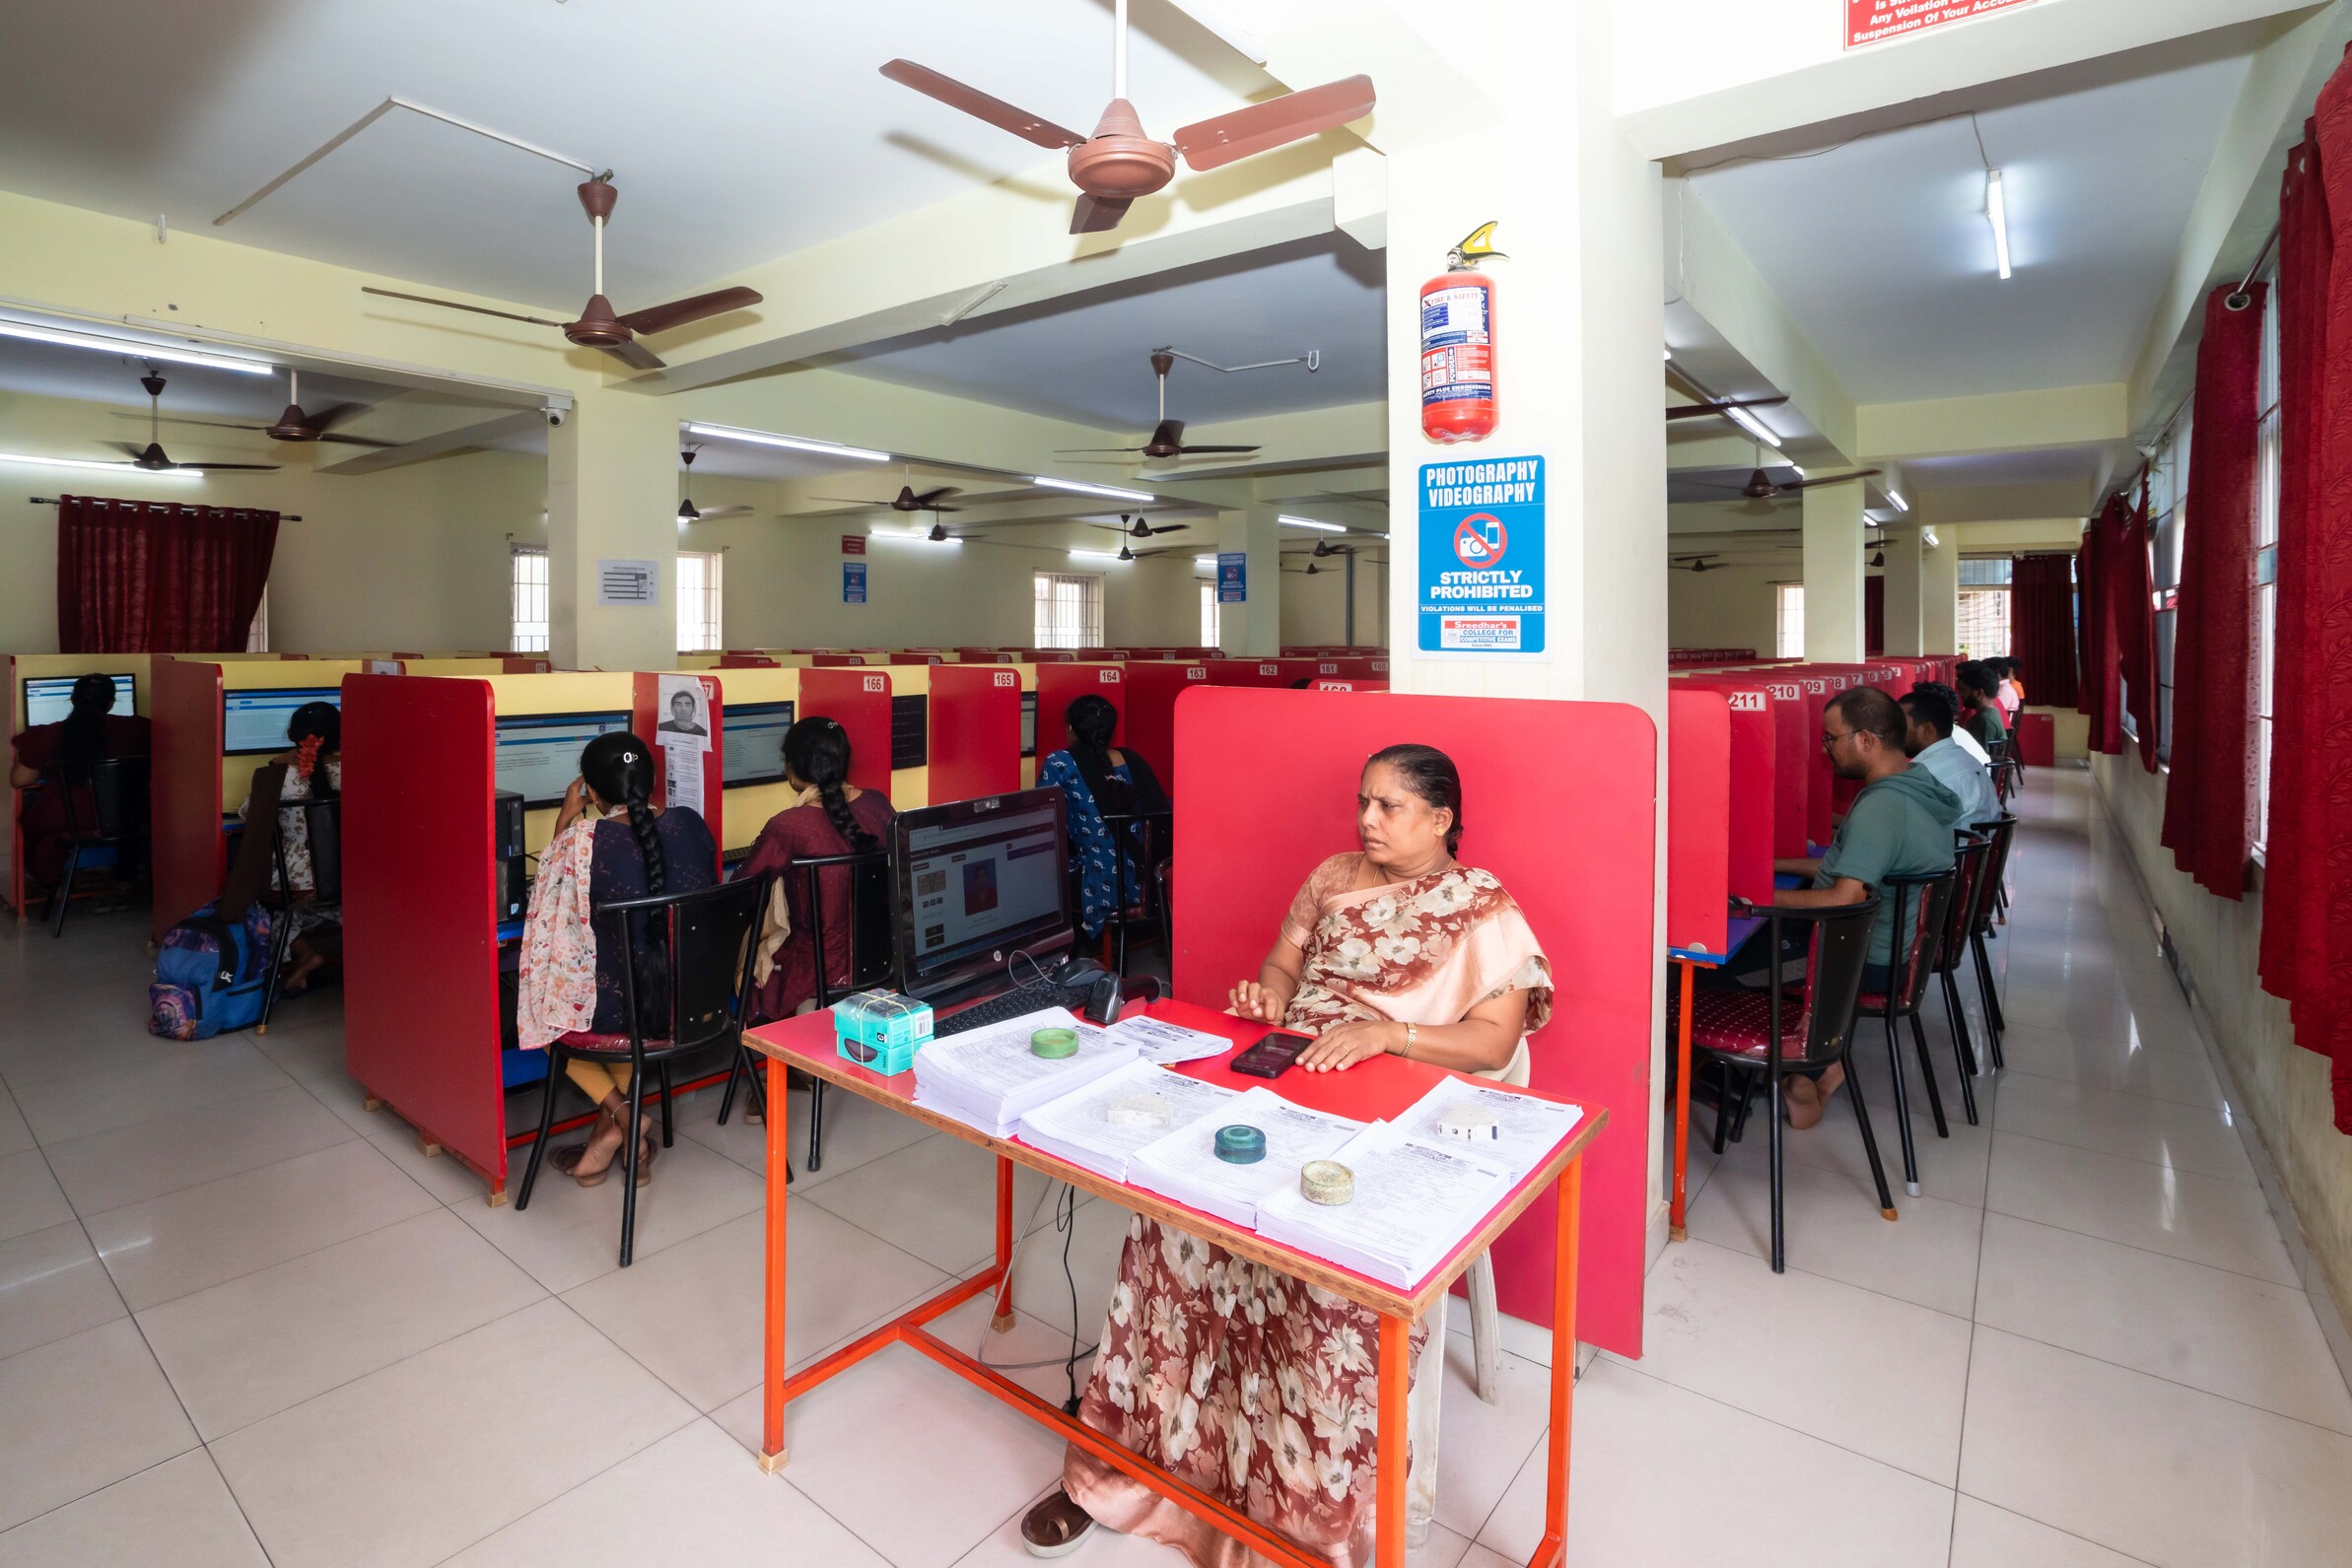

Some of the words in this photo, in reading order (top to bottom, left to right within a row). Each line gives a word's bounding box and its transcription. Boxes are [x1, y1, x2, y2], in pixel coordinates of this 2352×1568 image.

[1869, 13, 1893, 26] Any
[1896, 0, 1950, 19] Voilation
[1853, 19, 1922, 42] Suspension
[1924, 12, 1940, 25] Of
[1941, 6, 1971, 20] Your
[1431, 297, 1445, 306] FIRE
[1426, 460, 1538, 487] PHOTOGRAPHY
[1428, 482, 1535, 508] VIDEOGRAPHY
[1440, 571, 1523, 584] STRICTLY
[1430, 584, 1533, 599] PROHIBITED
[1189, 669, 1204, 678] 163
[1262, 665, 1276, 674] 162
[1321, 664, 1335, 673] 161
[996, 675, 1011, 685] 165
[1102, 671, 1117, 681] 164
[866, 678, 881, 690] 166
[1768, 685, 1795, 698] 210
[1730, 694, 1758, 708] 211
